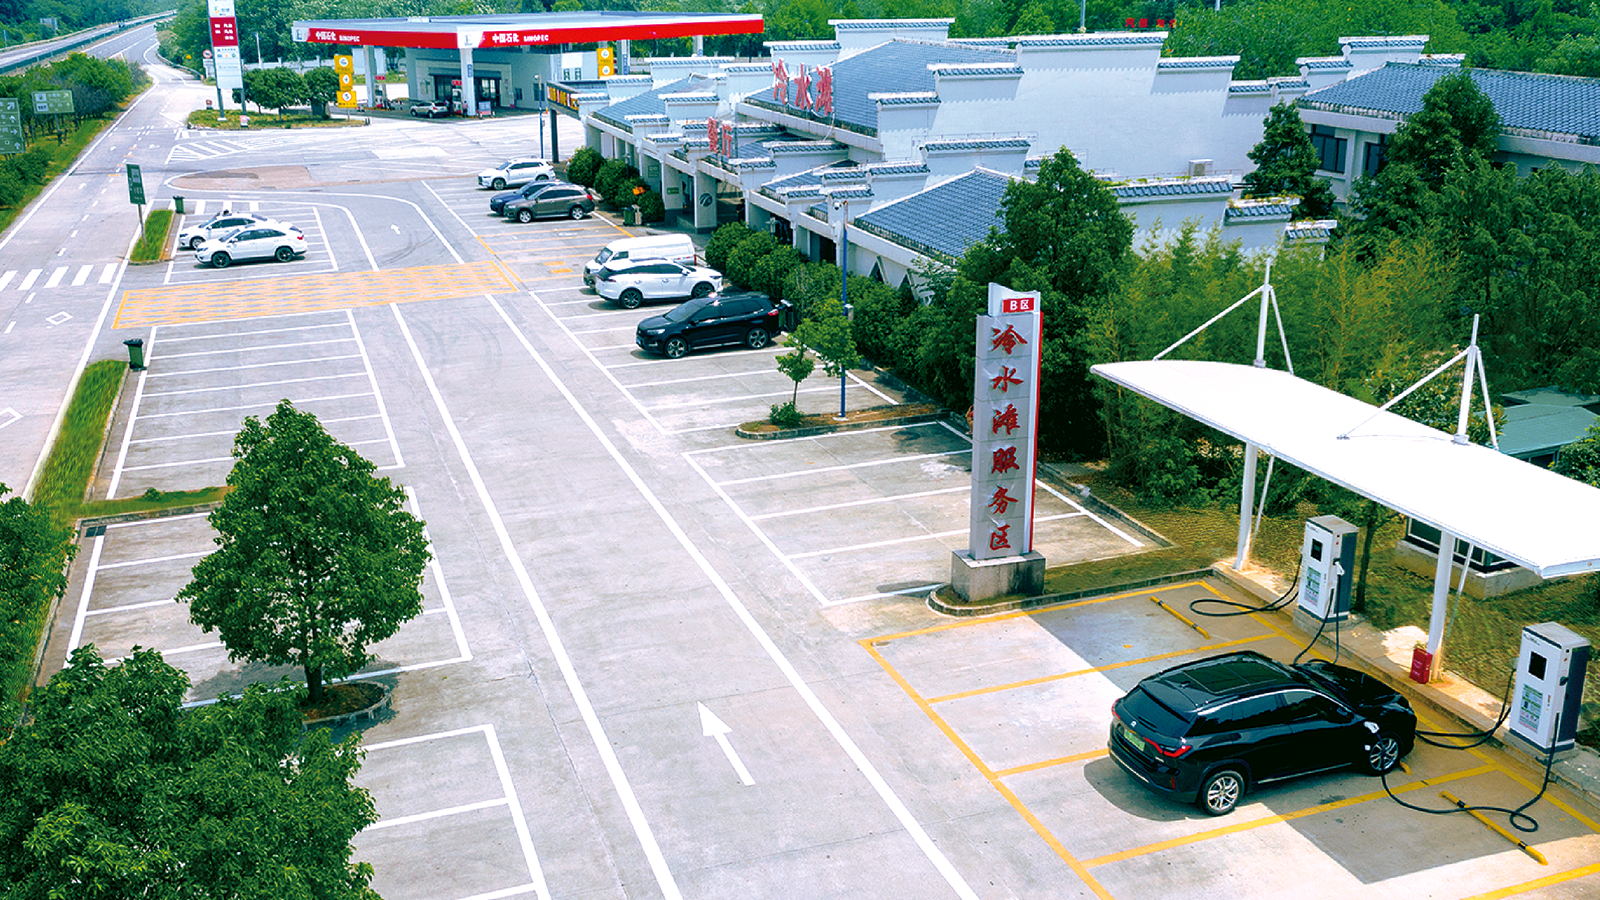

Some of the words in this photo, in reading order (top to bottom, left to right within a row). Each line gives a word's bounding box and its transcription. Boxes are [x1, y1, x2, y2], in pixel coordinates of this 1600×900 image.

[492, 33, 520, 43] 中国石化
[523, 34, 549, 42] SINOPEC
[772, 58, 833, 115] 冷水滩
[989, 325, 1028, 551] 冷水滩服务区
